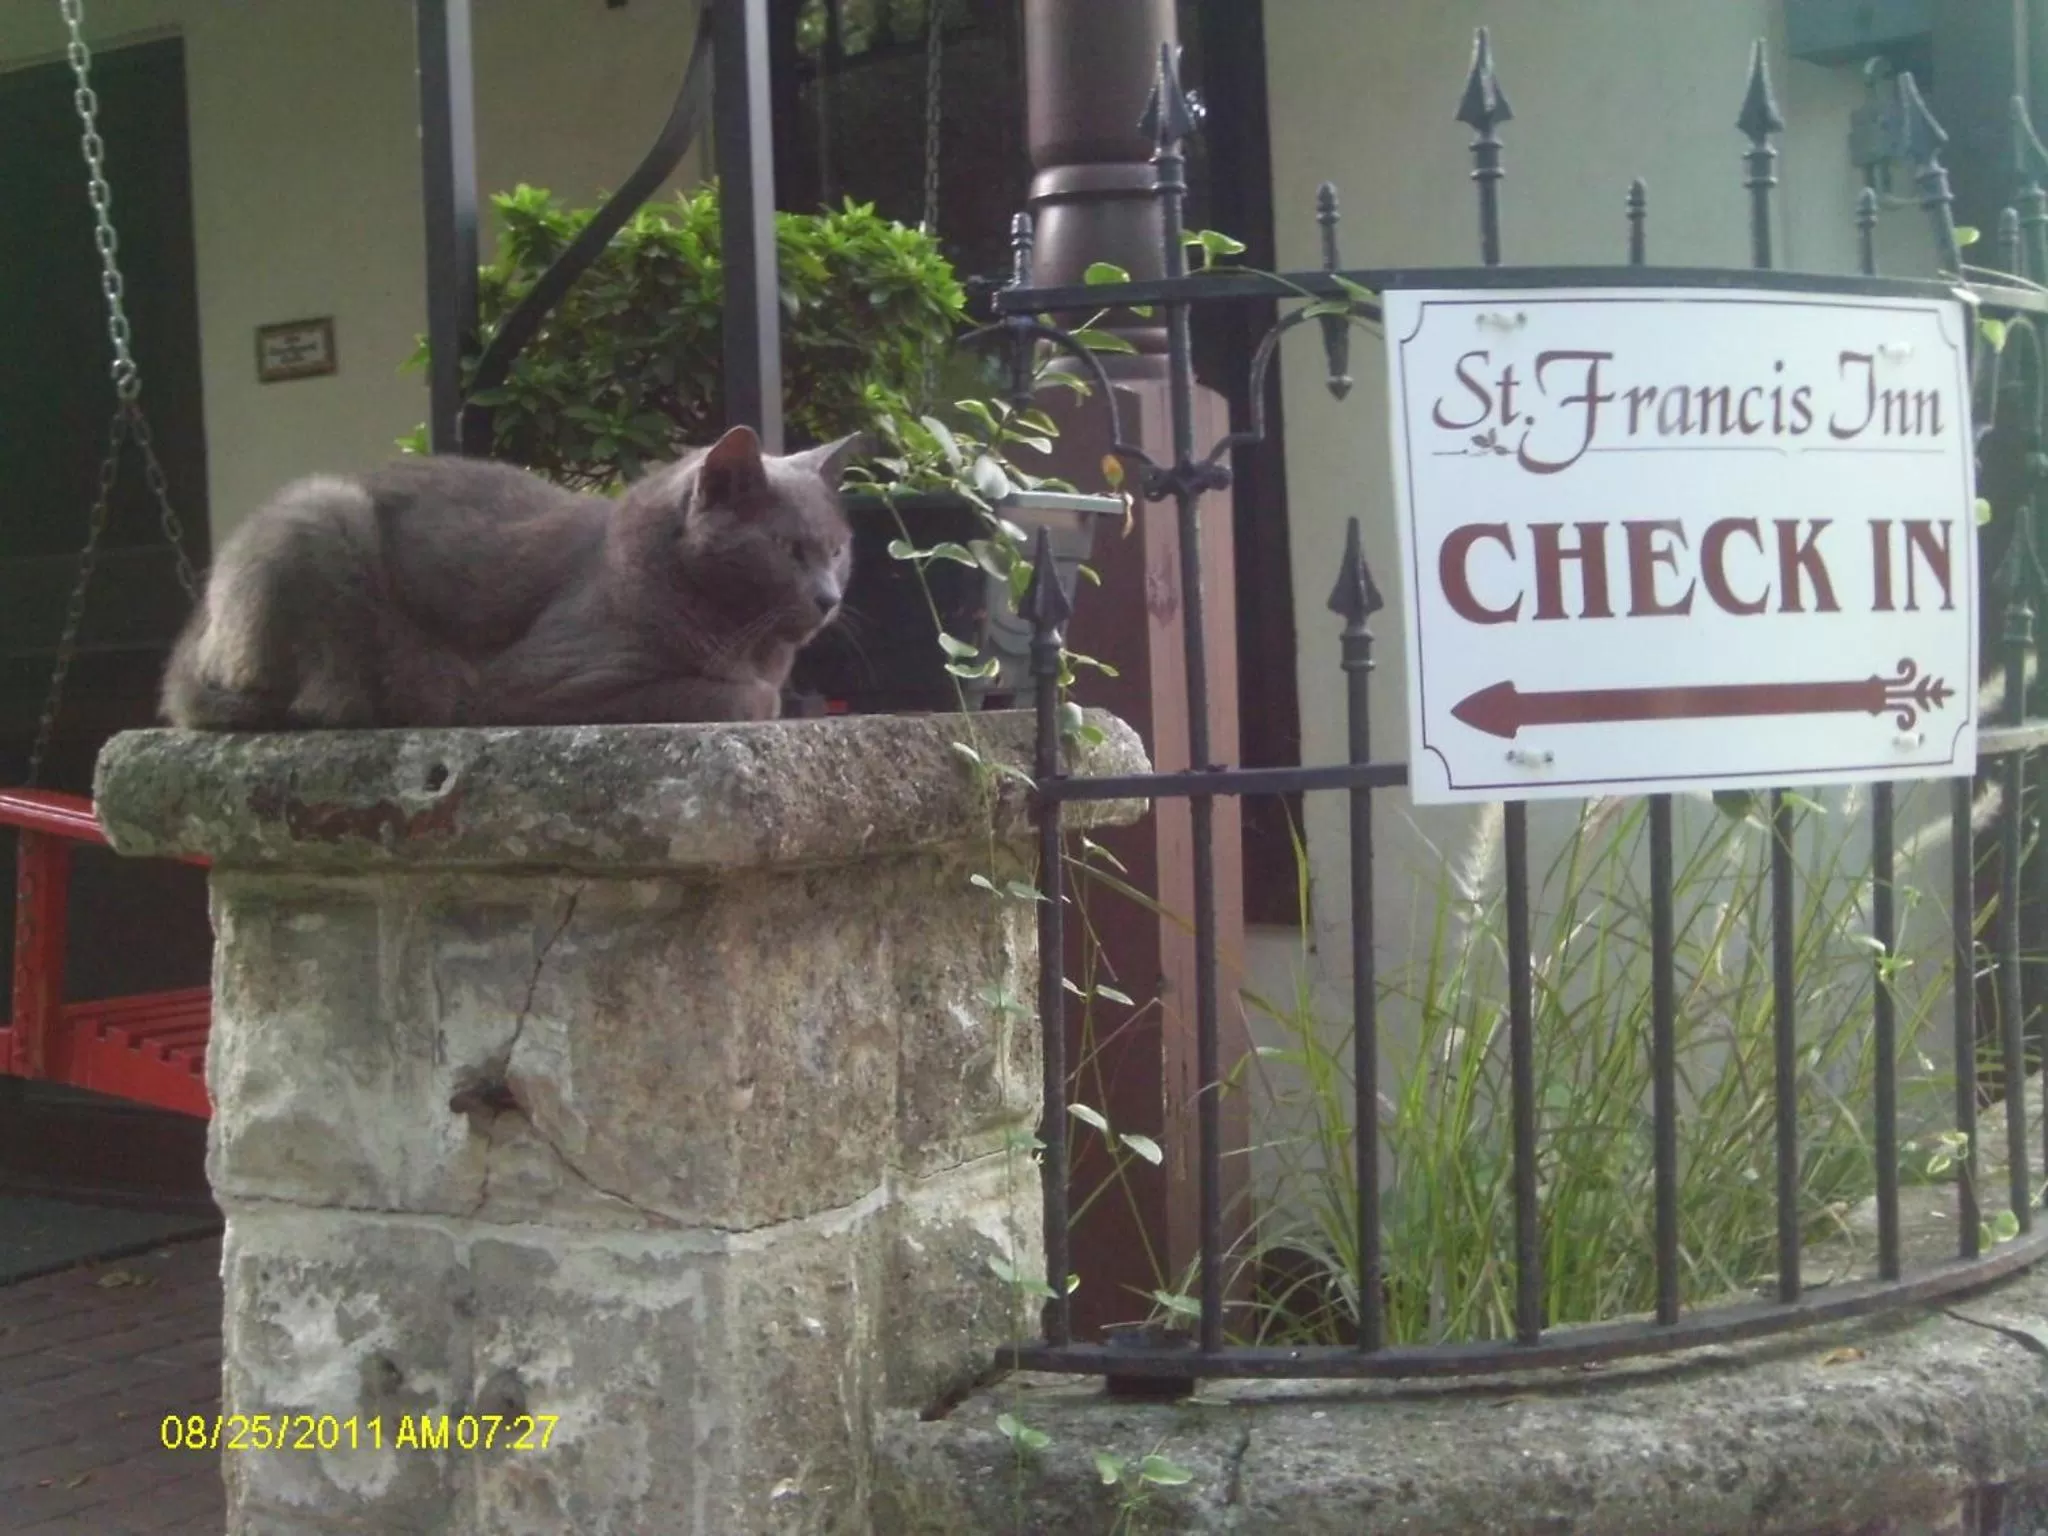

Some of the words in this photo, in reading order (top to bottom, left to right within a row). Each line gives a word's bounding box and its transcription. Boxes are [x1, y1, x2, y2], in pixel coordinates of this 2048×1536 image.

[1432, 350, 1534, 430] St.
[1518, 350, 1813, 474] Francis
[1829, 350, 1945, 439] Inn
[1438, 517, 1842, 624] CHECK
[1867, 518, 1957, 613] IN
